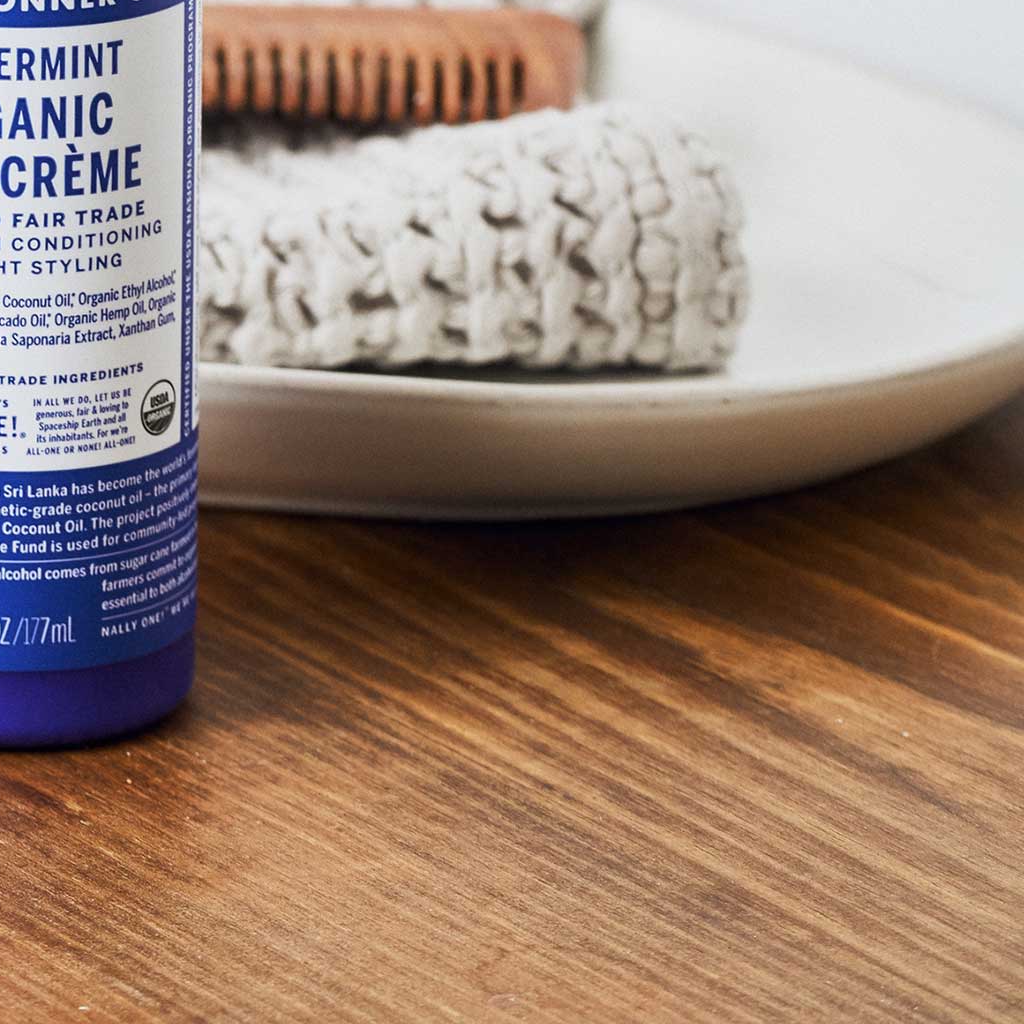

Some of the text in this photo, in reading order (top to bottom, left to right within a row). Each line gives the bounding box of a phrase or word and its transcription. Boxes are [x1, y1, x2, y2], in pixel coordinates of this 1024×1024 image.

[186, 78, 194, 145] ORGANIC
[0, 143, 142, 198] CRÈME
[12, 212, 66, 228] FAIR
[76, 200, 145, 225] TRADE
[11, 219, 162, 251] CONDITIONING
[31, 253, 122, 274] STYLING
[2, 293, 51, 308] Coconut
[78, 288, 119, 307] Organic
[122, 283, 145, 300] Ethyl
[55, 311, 97, 328] Organic
[101, 307, 129, 322] Hemp
[11, 332, 70, 349] Saponaria
[119, 319, 155, 338] Xanthan
[54, 362, 144, 384] INGREDIENTS
[33, 390, 121, 407] IN ALL WE LET US
[77, 403, 121, 416] fair loving
[150, 391, 169, 408] USDA
[39, 415, 117, 432] Spaceship Earth and
[36, 428, 109, 443] its For
[64, 445, 75, 454] OR
[4, 484, 23, 498] Sri
[27, 484, 68, 498] Lanka
[71, 482, 95, 496] has
[98, 474, 142, 493] become
[144, 466, 161, 482] the
[76, 495, 126, 513] coconut
[129, 490, 143, 505] oil
[2, 521, 61, 535] Coconut
[91, 515, 113, 531] The
[117, 505, 154, 529] project
[12, 540, 47, 553] Fund
[51, 539, 63, 552] is
[67, 536, 99, 552] used
[103, 532, 120, 547] for
[44, 566, 86, 580] comes
[89, 561, 117, 576] from
[119, 552, 147, 571] sugar
